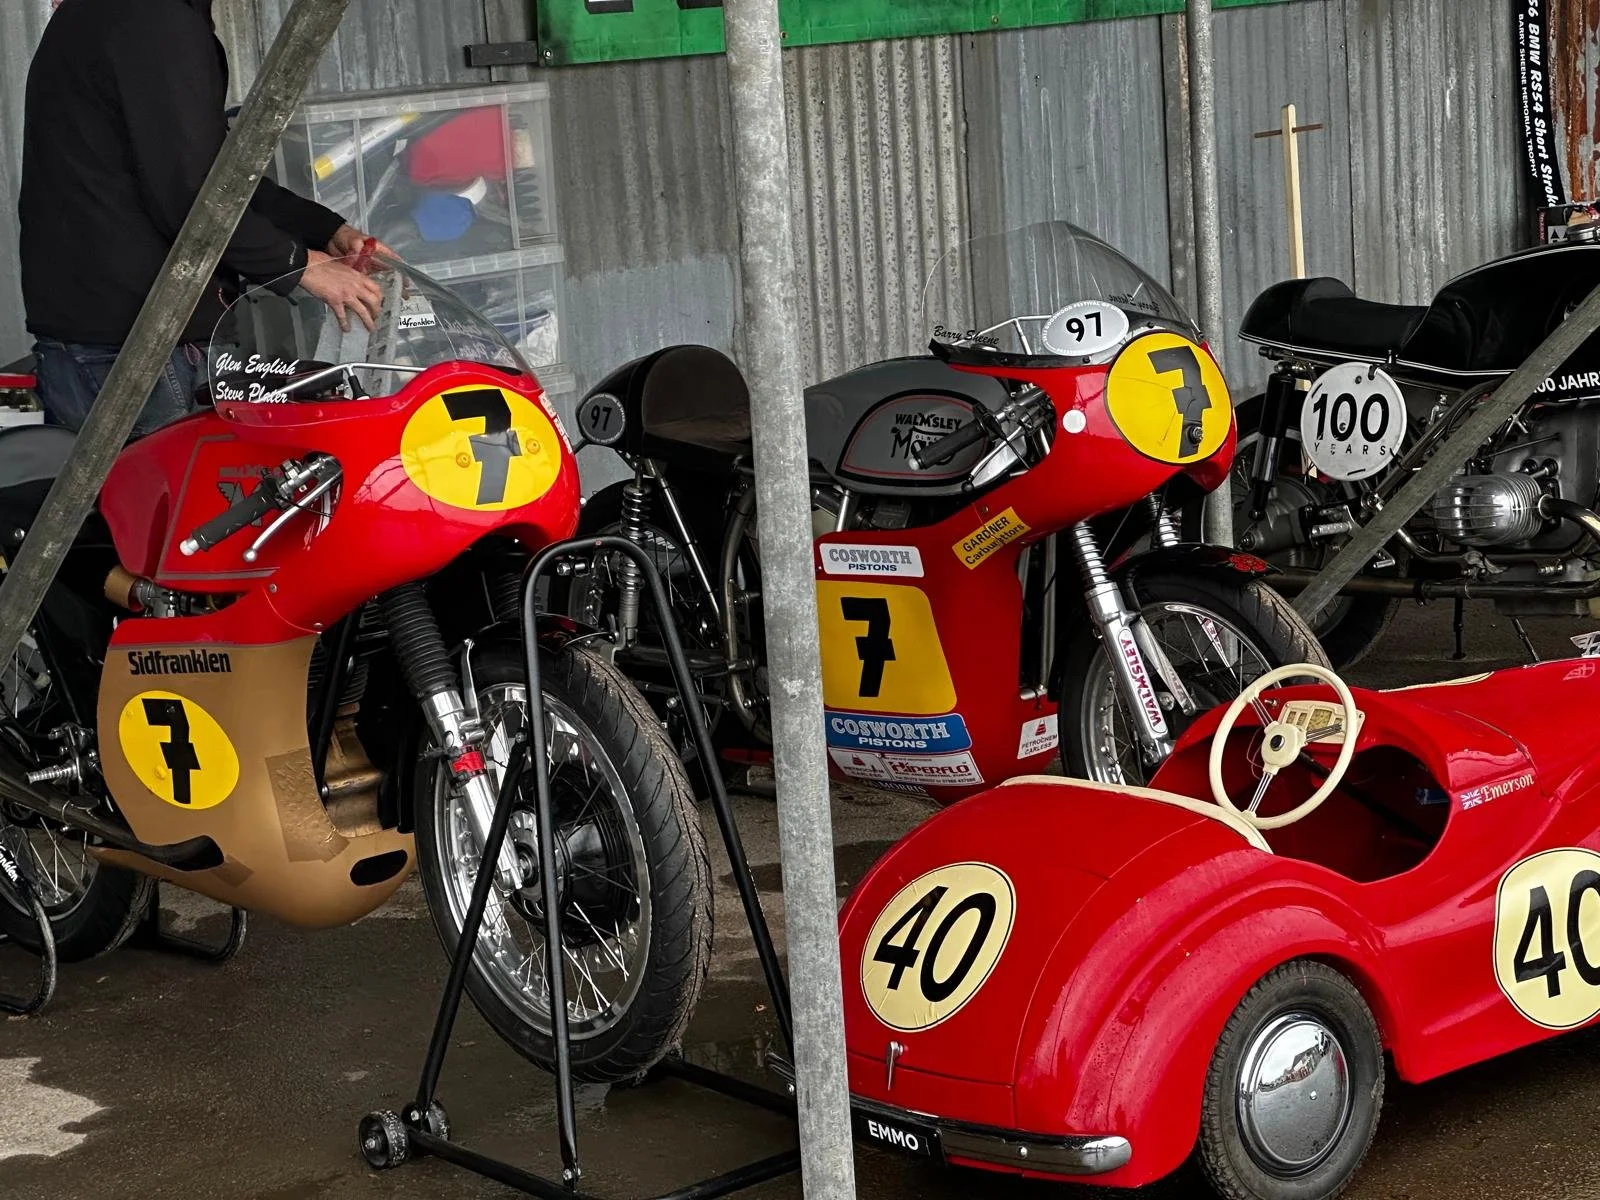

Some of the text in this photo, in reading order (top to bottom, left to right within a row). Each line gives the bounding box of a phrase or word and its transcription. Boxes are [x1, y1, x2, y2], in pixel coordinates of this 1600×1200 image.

[1528, 23, 1541, 66] BMW
[1519, 48, 1527, 85] SHEENE
[1530, 69, 1544, 113] RS54
[1521, 87, 1531, 138] MEMORIAL
[1534, 117, 1549, 160] Short
[1526, 138, 1538, 178] TROPHY
[933, 325, 1000, 345] Barry Sheene
[1065, 311, 1102, 343] 97
[215, 352, 300, 379] Glen English
[215, 380, 288, 404] Steve Plater
[1533, 371, 1600, 394] 00 JAHR
[590, 404, 613, 432] 97
[1147, 345, 1213, 459] 7
[1312, 392, 1390, 443] 100
[895, 412, 963, 433] WALMSLEY
[440, 388, 523, 506] 7
[963, 516, 1010, 553] GARDNER
[828, 548, 913, 565] COSWORTH
[848, 563, 898, 572] PISTONS
[127, 649, 233, 676] Sidfranklen
[840, 596, 897, 698] 7
[1121, 638, 1163, 728] WALMSLEY
[831, 717, 951, 740] COSWORTH
[858, 737, 928, 749] PISTONS
[1021, 733, 1058, 750] PETROCHEM
[141, 698, 202, 805] 7
[1024, 741, 1053, 755] CARLESS
[1480, 773, 1535, 802] Emerson
[872, 885, 997, 1003] 40
[1513, 869, 1600, 999] 40
[868, 1119, 919, 1151] EMMO
